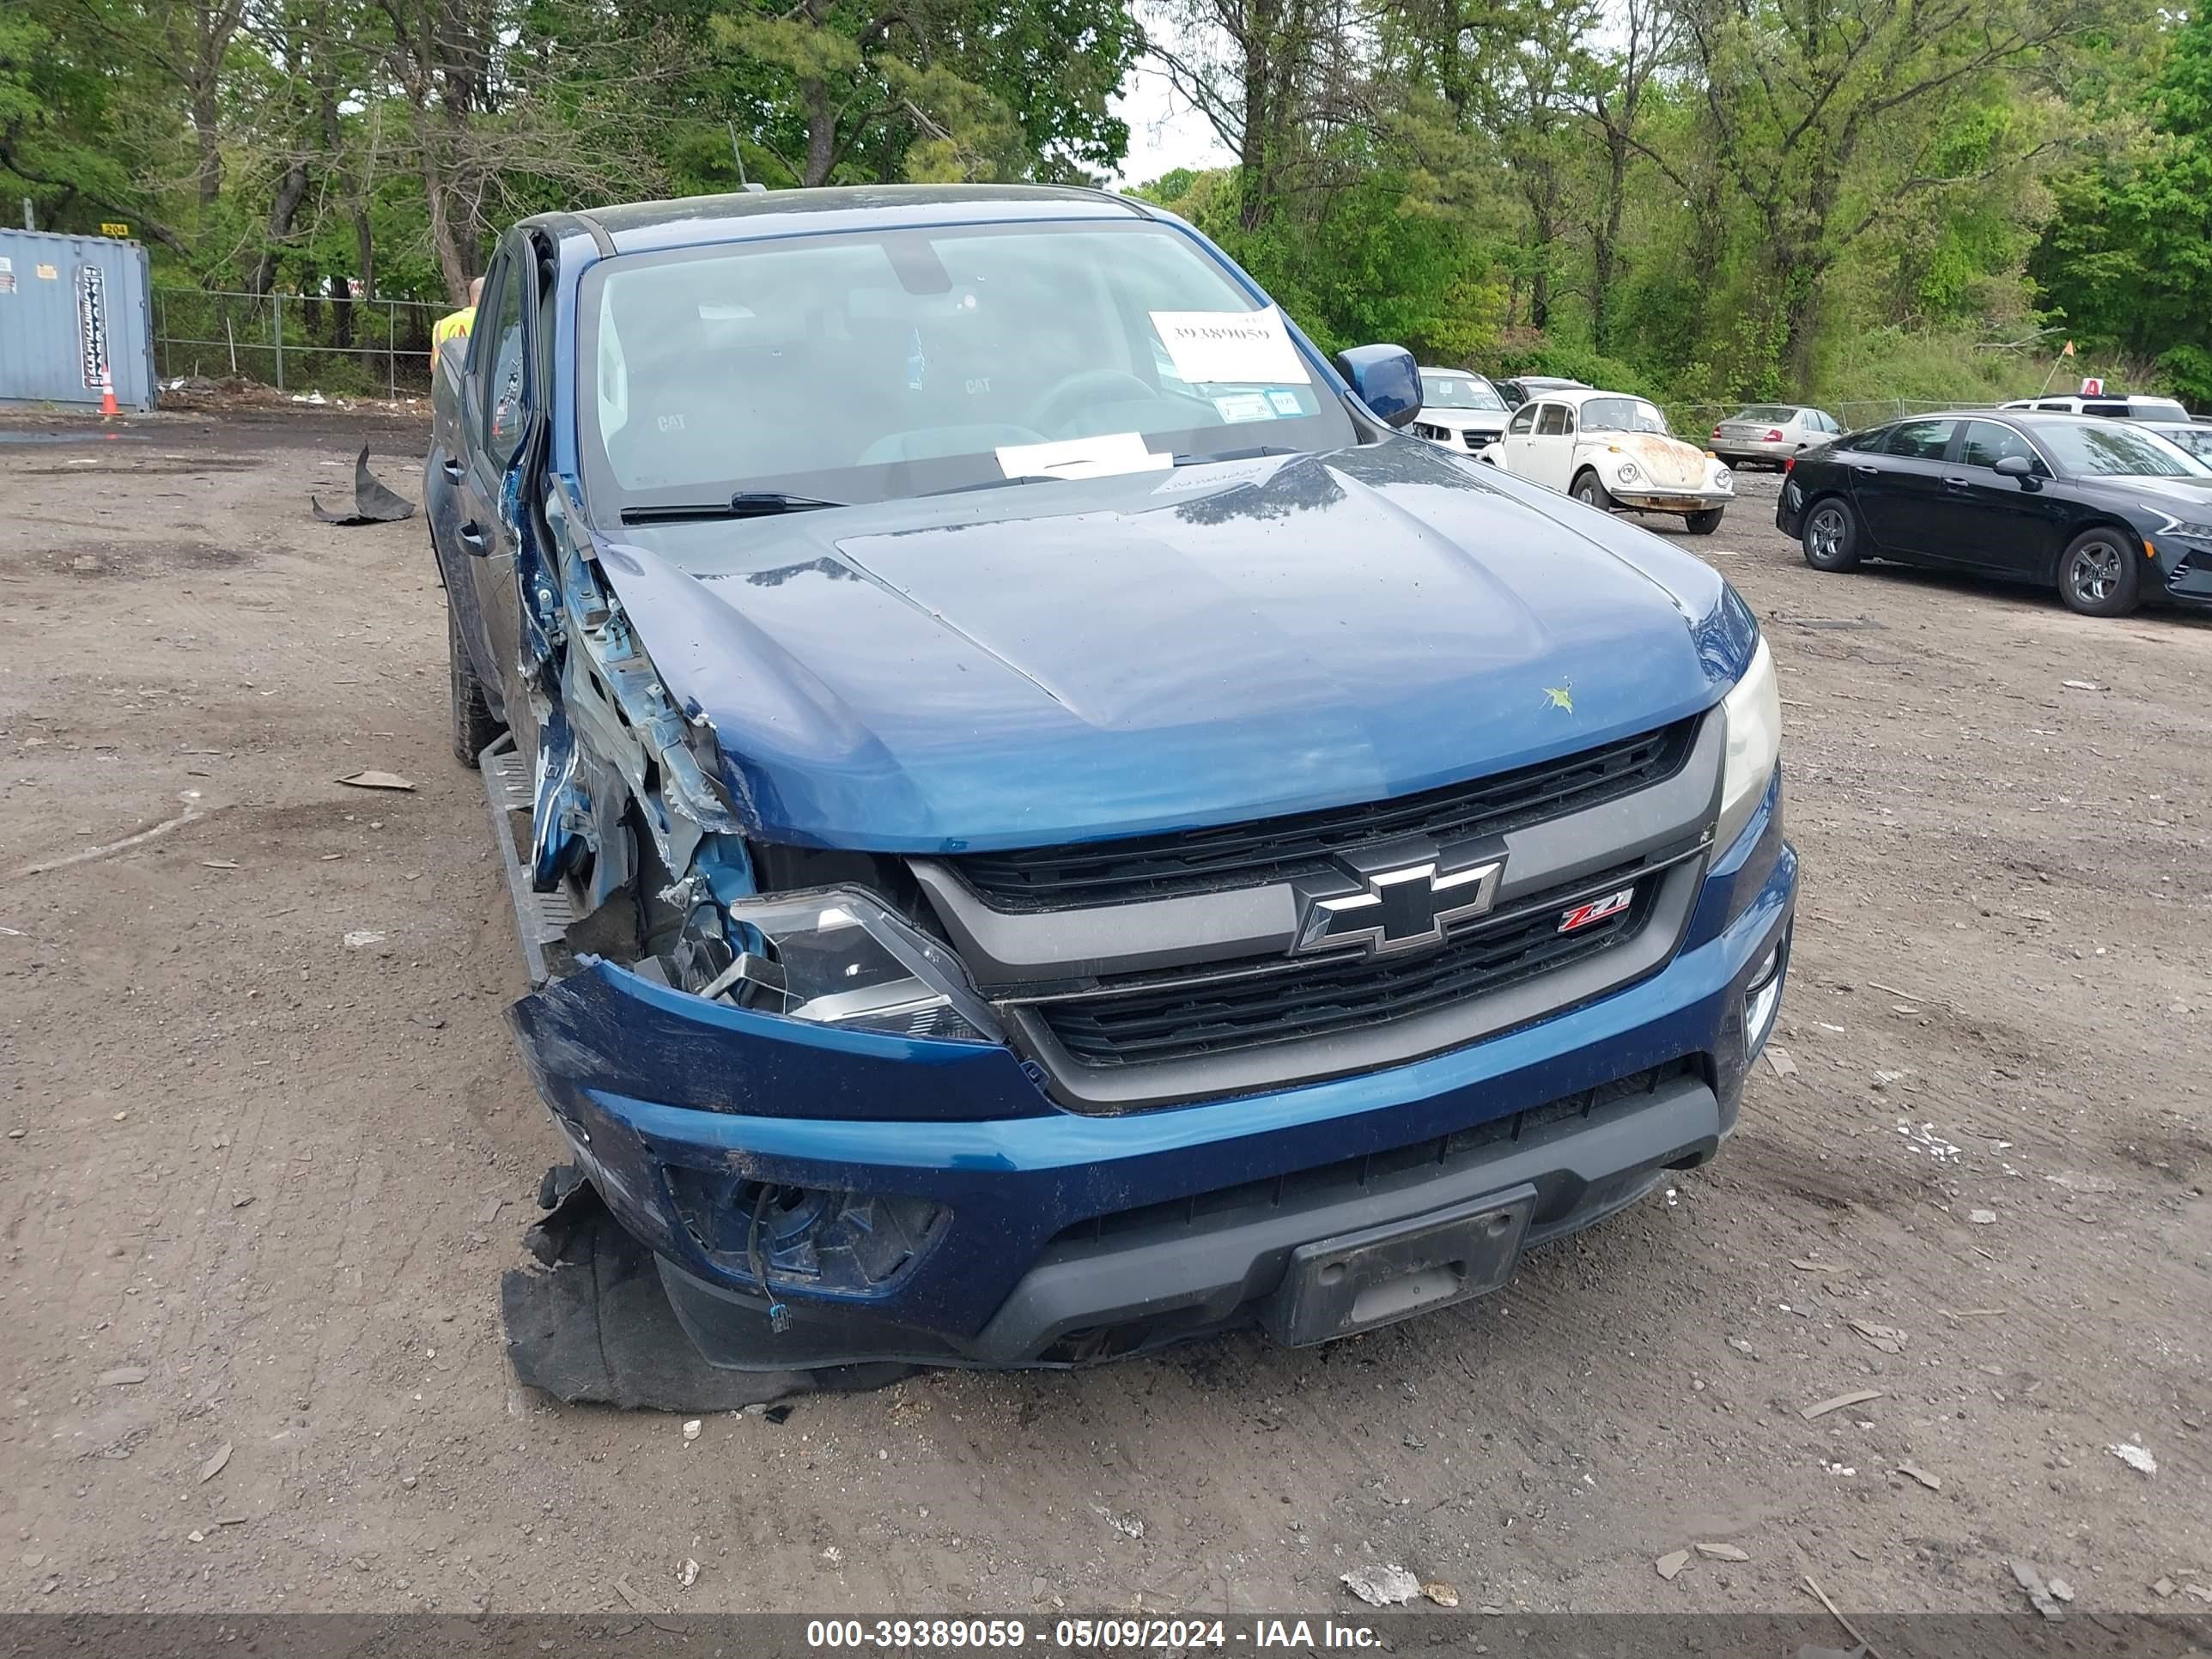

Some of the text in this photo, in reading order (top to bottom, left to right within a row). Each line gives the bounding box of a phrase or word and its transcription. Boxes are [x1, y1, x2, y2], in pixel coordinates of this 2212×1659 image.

[105, 225, 126, 234] 204
[1174, 327, 1271, 341] 39389059
[964, 378, 991, 394] CAT
[657, 414, 686, 433] CAT
[1557, 888, 1634, 933] Z71
